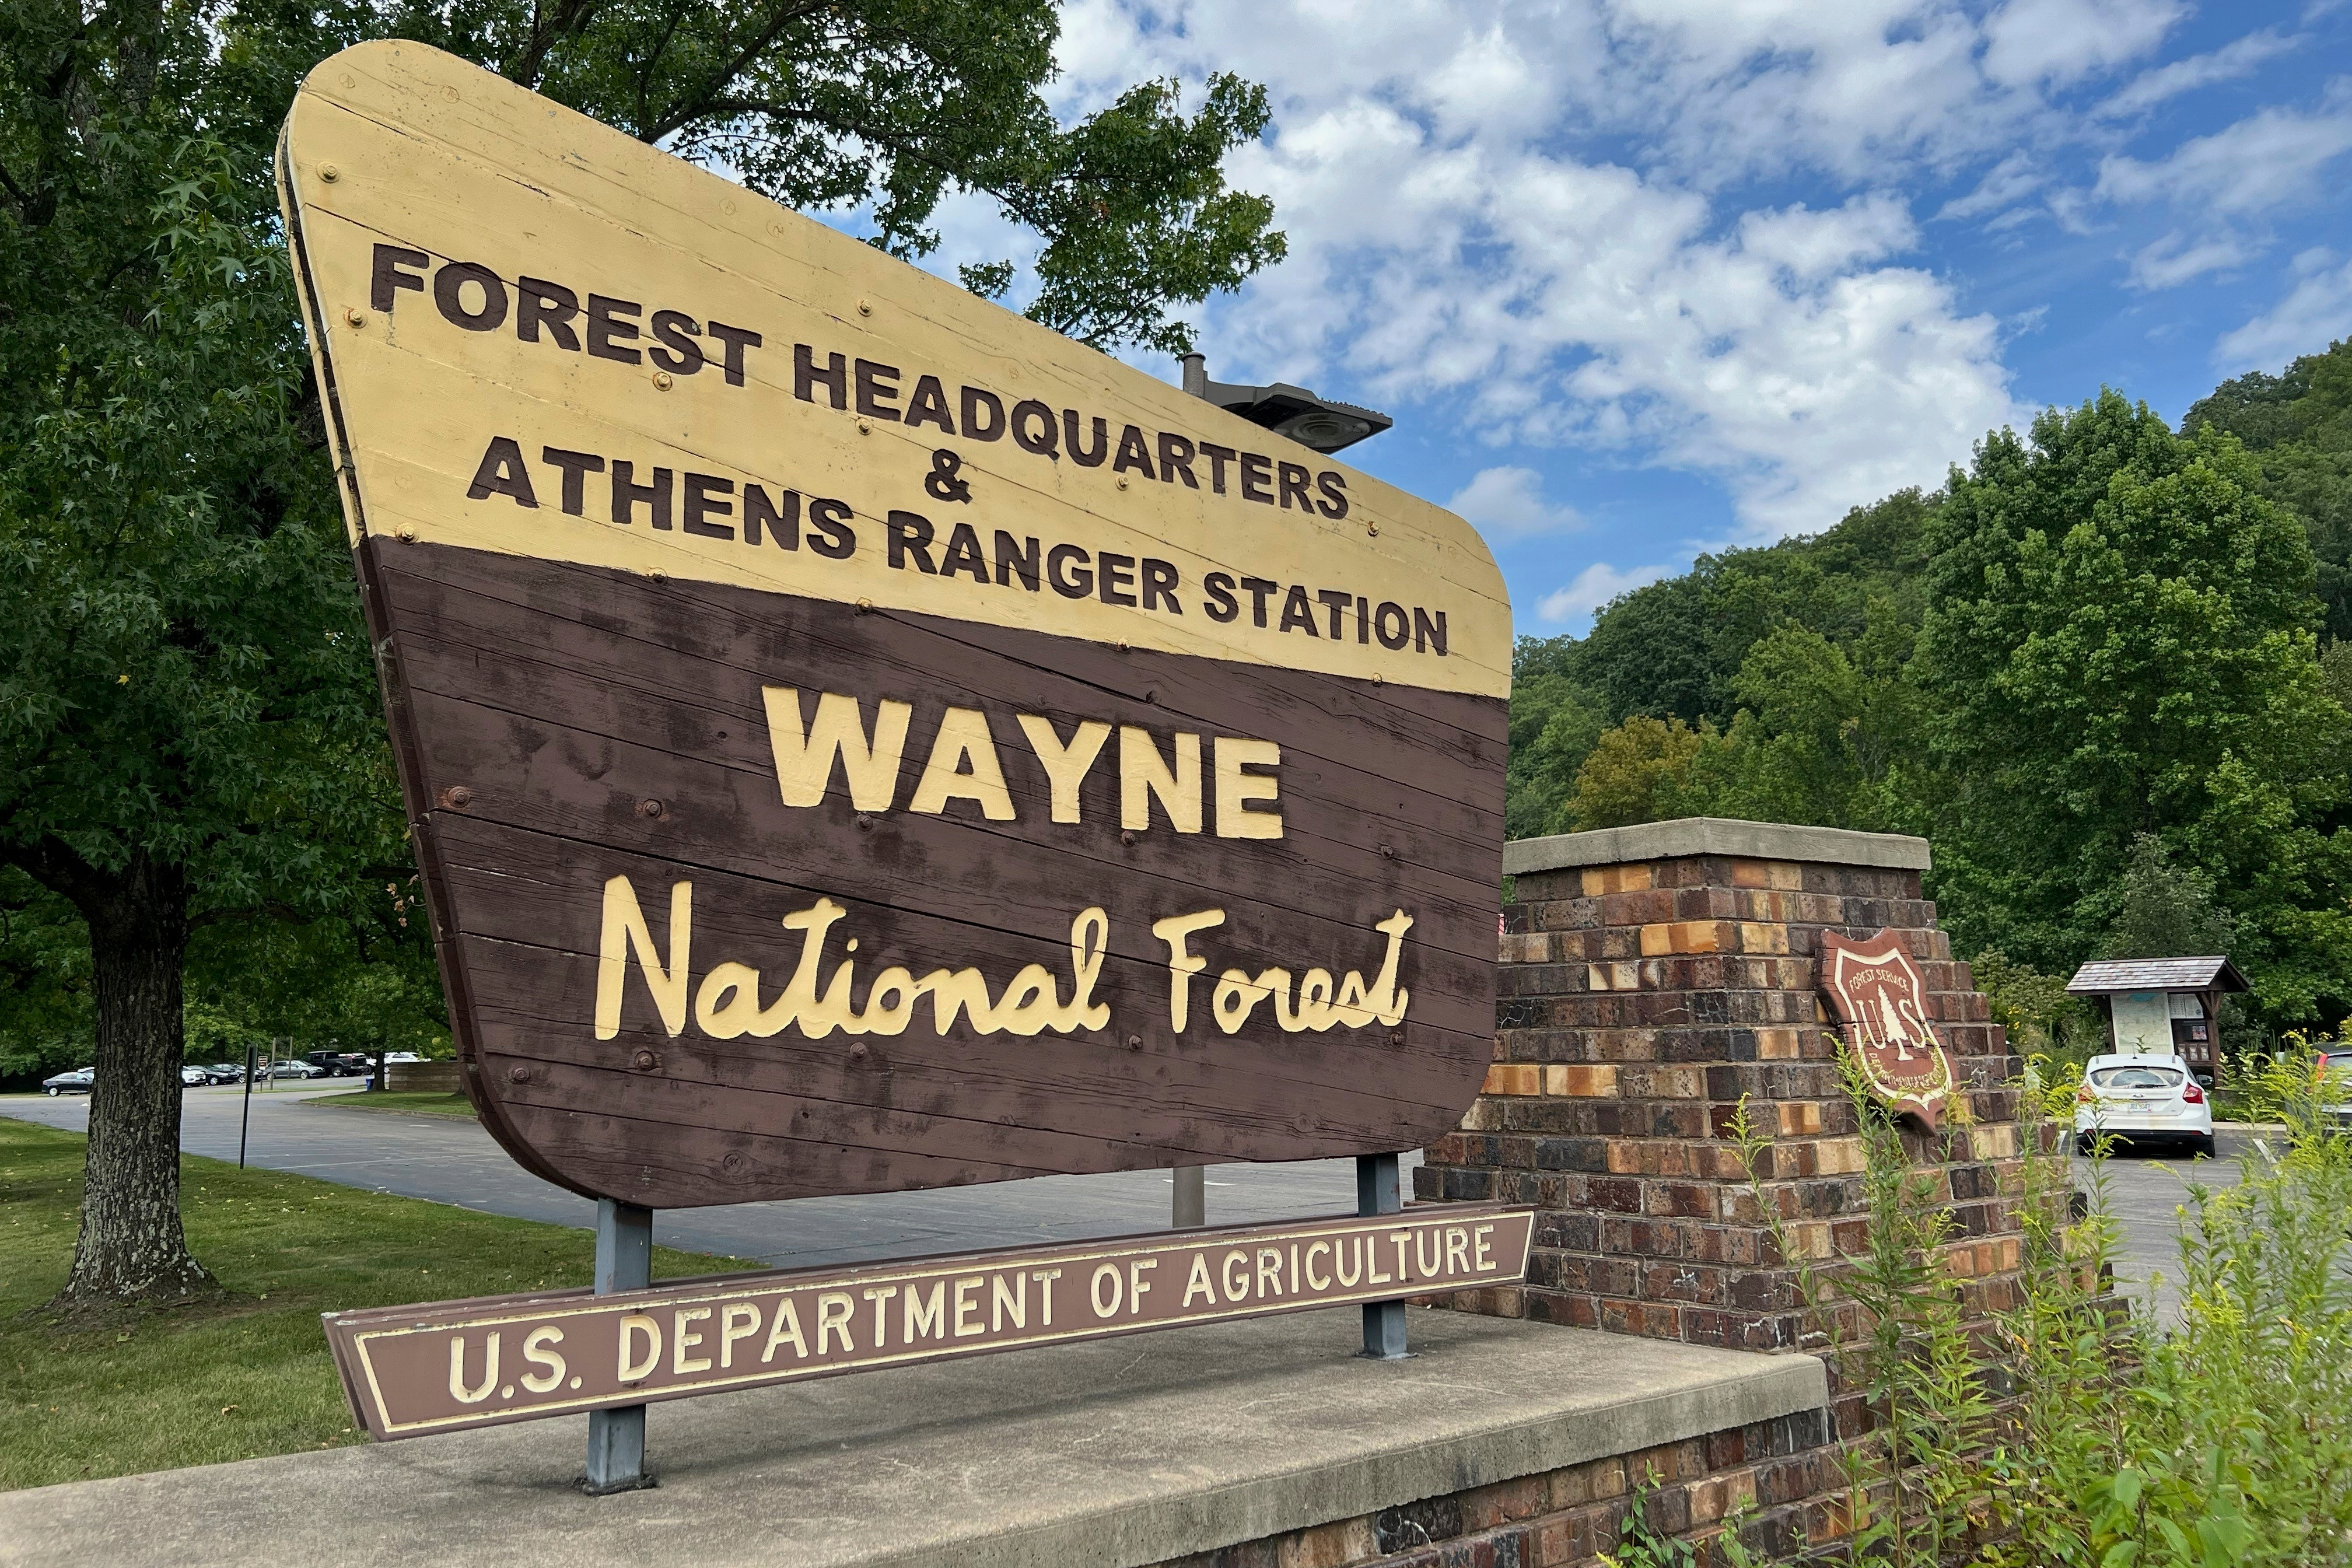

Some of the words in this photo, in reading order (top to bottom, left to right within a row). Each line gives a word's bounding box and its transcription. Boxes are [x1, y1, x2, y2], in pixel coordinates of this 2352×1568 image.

[371, 243, 762, 387] FOREST
[793, 343, 1349, 520] HEADQUARTERS
[467, 436, 856, 560] ATHENS
[887, 509, 1183, 615] RANGER
[1202, 572, 1448, 657] STATION
[924, 448, 974, 504] &
[762, 686, 1283, 839] WAYNE
[594, 875, 1111, 1041] National
[1153, 908, 1414, 1034] Forest
[1849, 969, 1875, 993] FOREST
[1875, 969, 1909, 992] SERVICE
[449, 1325, 583, 1404] U.S.
[617, 1268, 1062, 1382] DEPARTMENT
[1090, 1258, 1158, 1318] OF
[1182, 1224, 1498, 1308] AGRICULTURE
